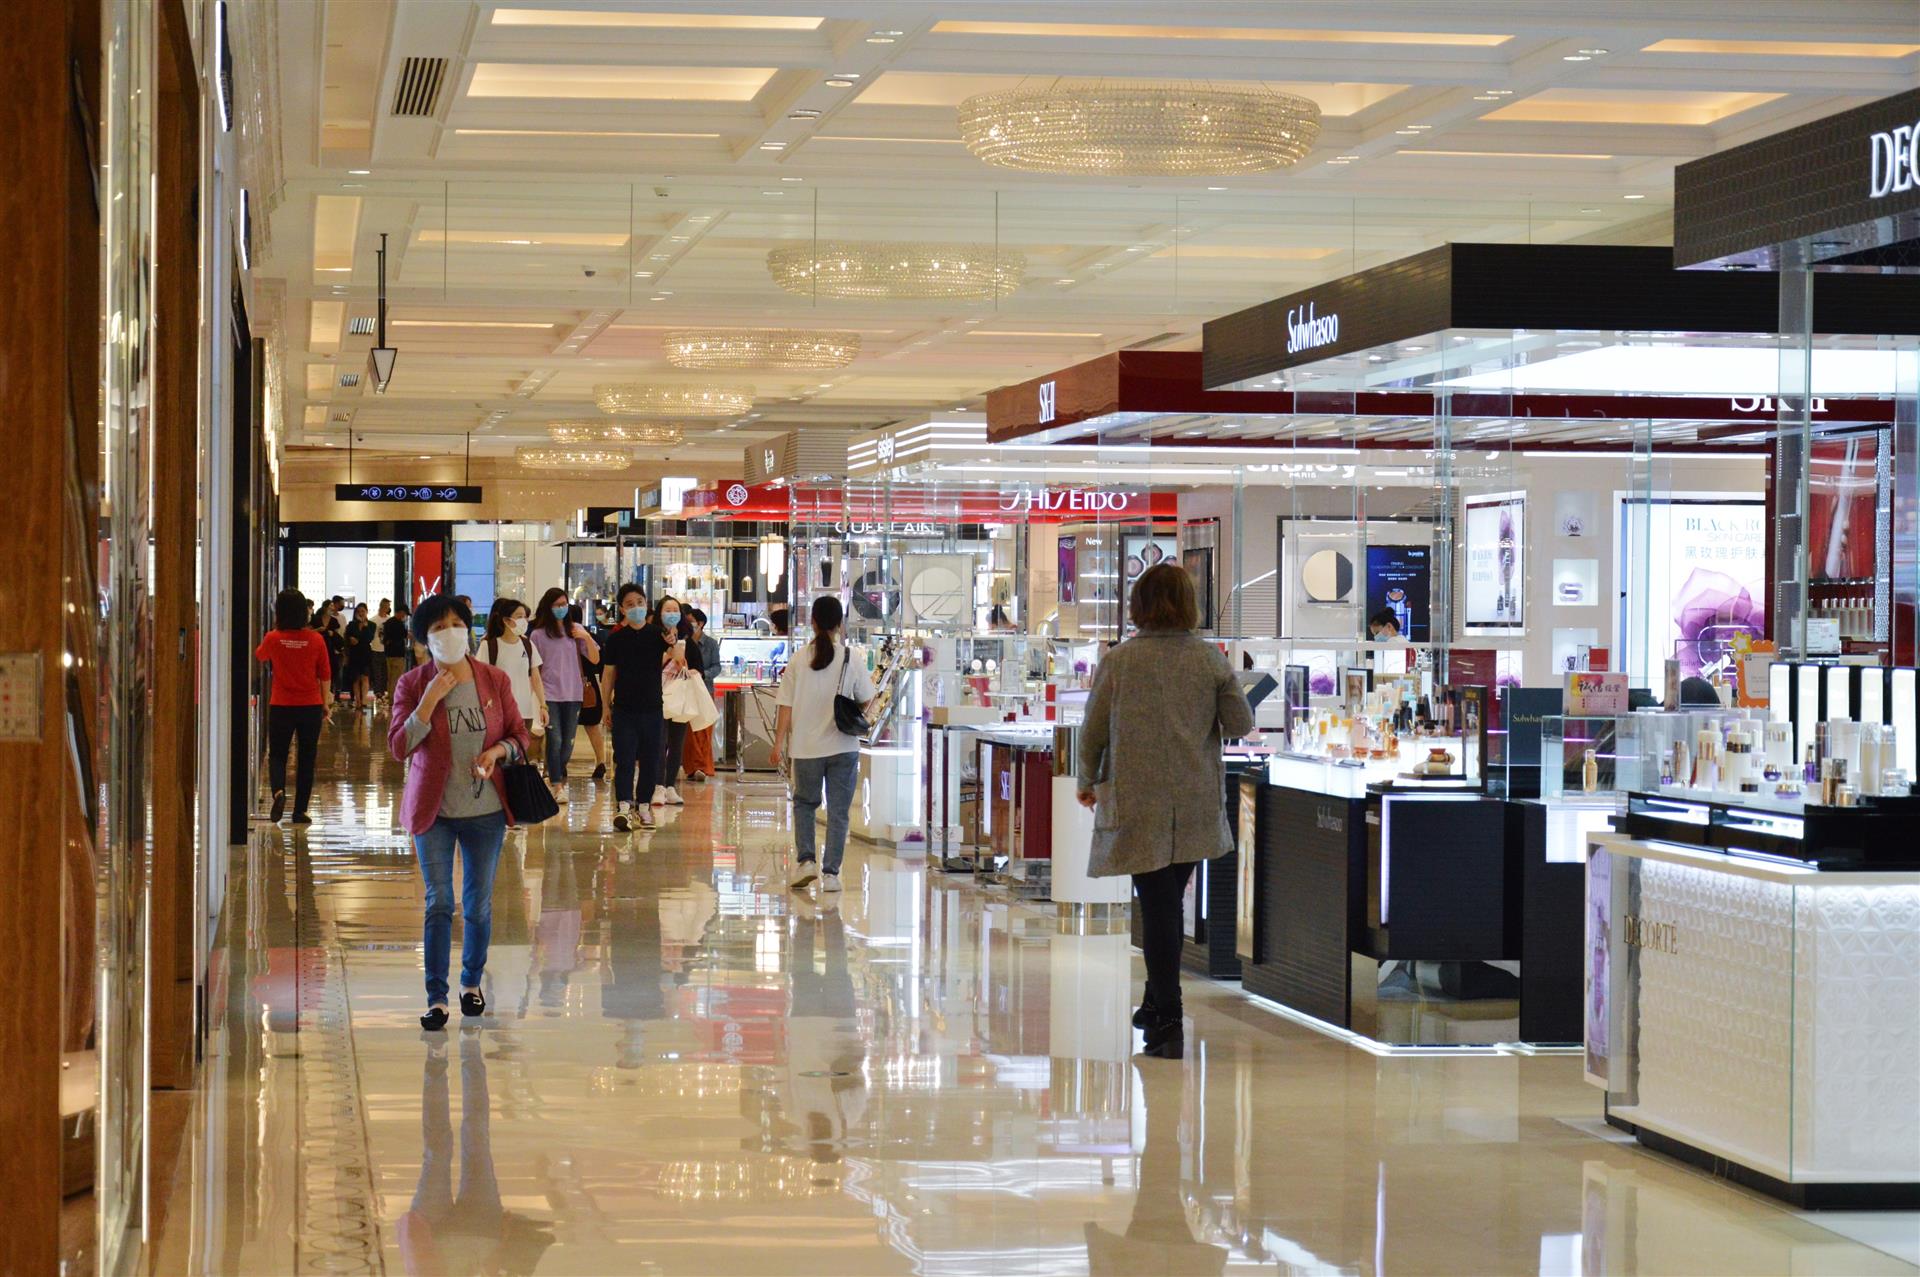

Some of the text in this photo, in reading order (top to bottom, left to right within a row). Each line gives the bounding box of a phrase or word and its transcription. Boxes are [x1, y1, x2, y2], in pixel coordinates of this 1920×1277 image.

[1287, 301, 1338, 353] Sulwhasoo
[1085, 536, 1103, 546] New
[1685, 546, 1765, 561] 黑玫瑰护肤
